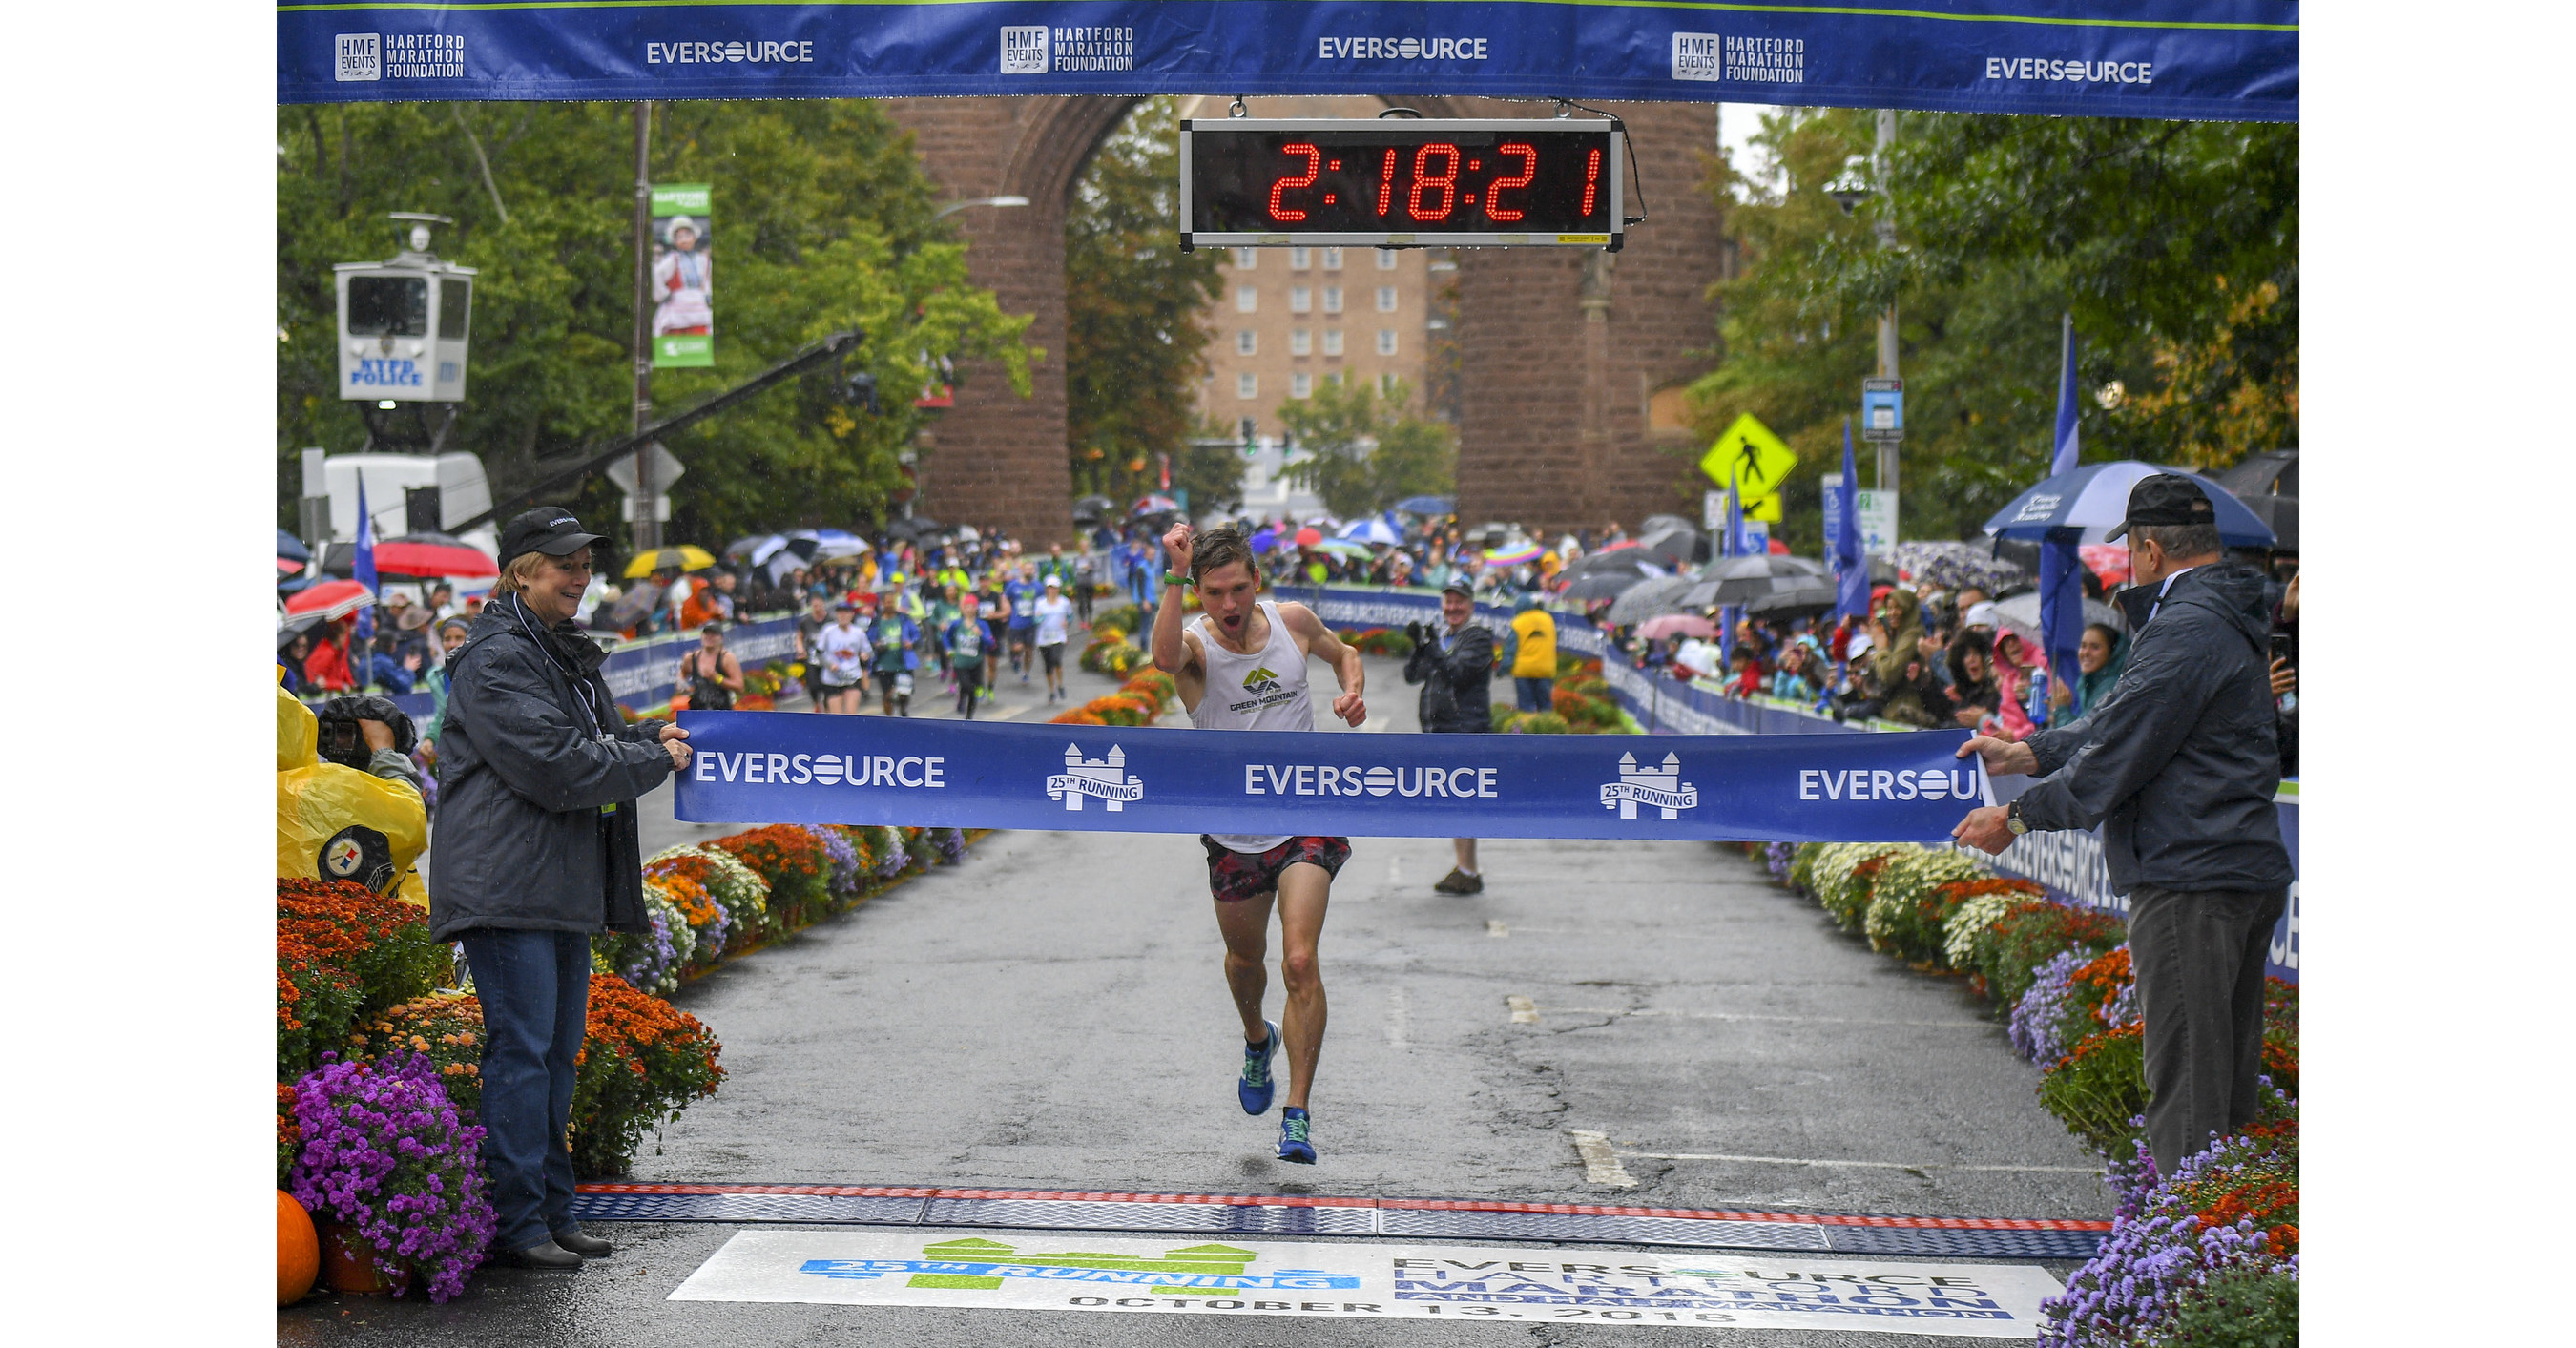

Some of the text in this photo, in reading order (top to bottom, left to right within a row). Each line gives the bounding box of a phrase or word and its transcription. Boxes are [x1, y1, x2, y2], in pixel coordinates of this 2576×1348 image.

[386, 35, 464, 49] HARTFORD
[1008, 31, 1042, 48] HMF
[1055, 27, 1133, 41] HARTFORD
[342, 39, 375, 55] HMF
[647, 41, 813, 63] EVERSOURCE
[1055, 42, 1133, 56] MARATHON
[1319, 37, 1487, 59] EVERSOURCE
[1679, 38, 1714, 55] HMF
[1726, 36, 1803, 53] HARTFORD
[342, 56, 376, 69] EVENTS
[386, 50, 464, 63] MARATHON
[1008, 48, 1043, 62] EVENTS
[1055, 56, 1133, 71] FOUNDATION
[1679, 55, 1714, 69] EVENTS
[1726, 52, 1803, 68] MARATHON
[386, 64, 464, 78] FOUNDATION
[1726, 66, 1803, 83] FOUNDATION
[1985, 57, 2152, 84] EVERSOURCE
[1269, 143, 1600, 221] 2:18:21
[351, 372, 423, 386] POLICE
[1230, 691, 1298, 711] GREEN MOUNTAIN
[696, 751, 945, 788] EVERSOURCE
[1078, 778, 1137, 798] RUNNING
[1245, 764, 1497, 798] EVERSOURCE
[1799, 769, 1983, 800] EVERSOU
[1632, 787, 1692, 806] RUNNING
[986, 1265, 1333, 1289] RUNNING
[1394, 1269, 1987, 1297] HARTFORD
[1395, 1279, 2001, 1309] MARATHON
[1068, 1296, 1737, 1322] OCTOBER 13, 2018
[1408, 1294, 1996, 1318] AND HALF MARATHON
